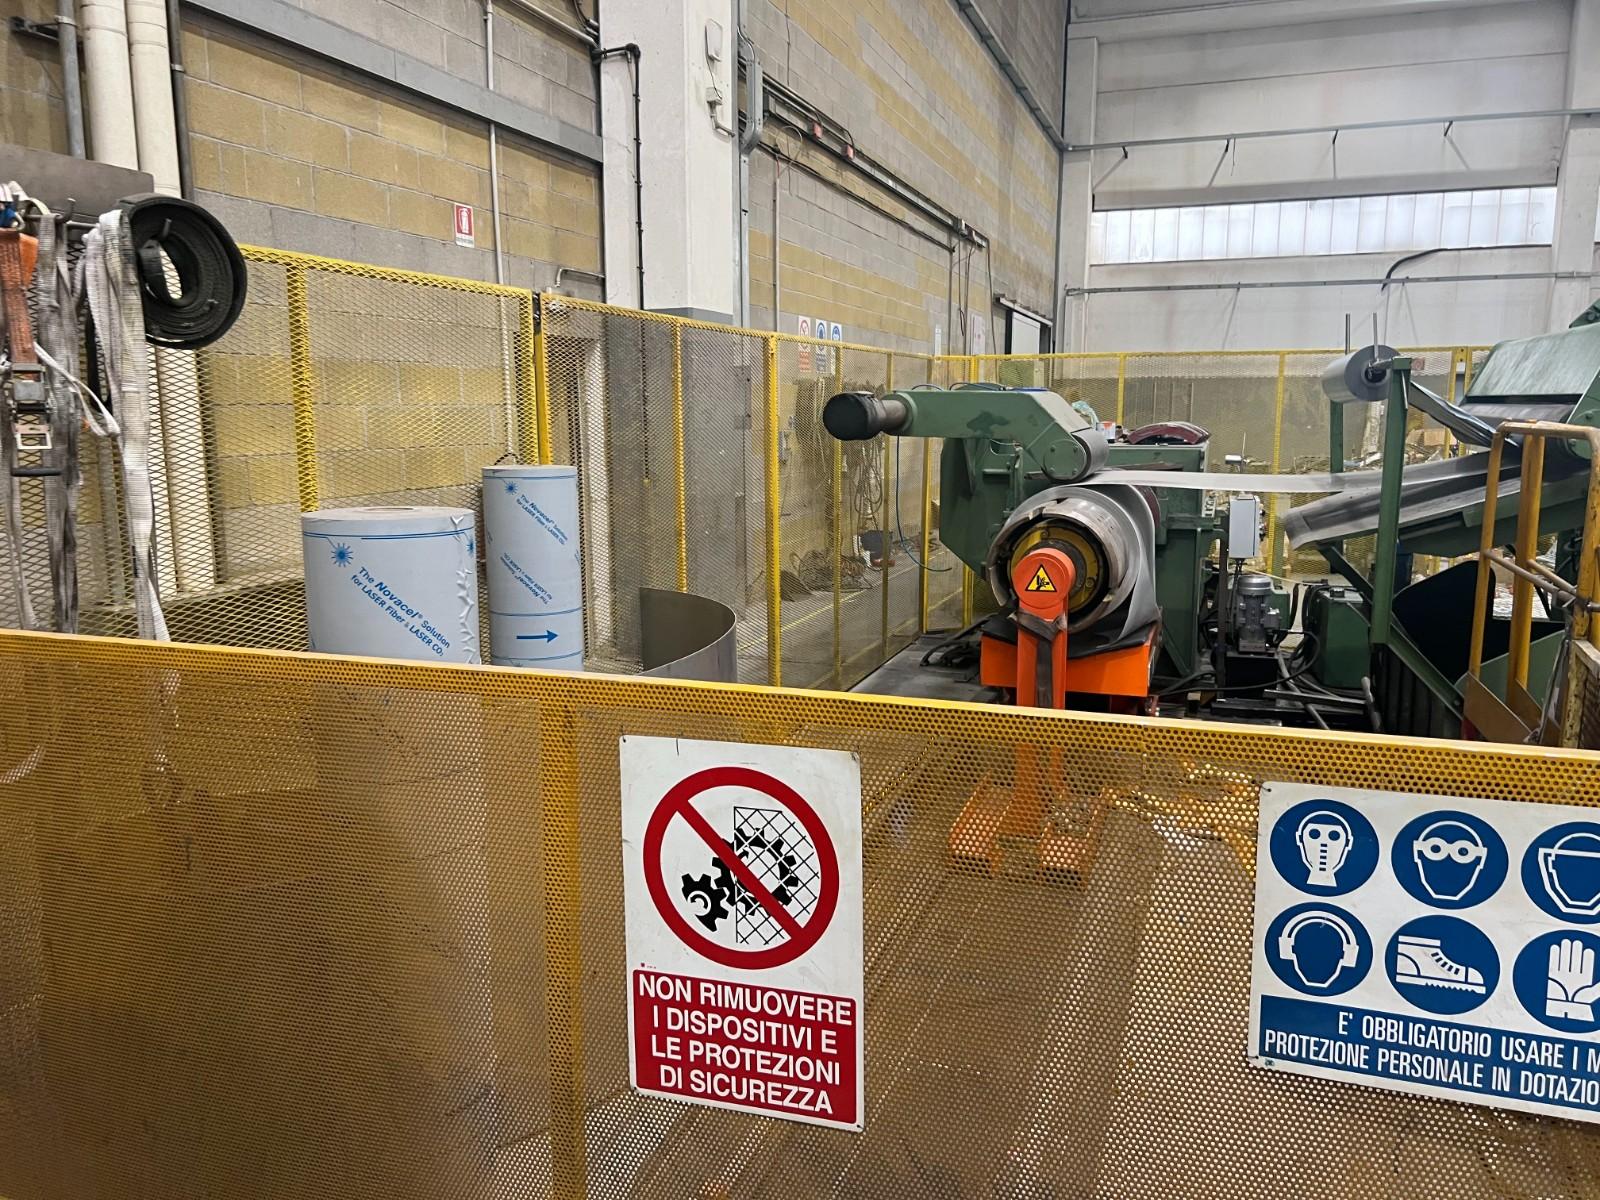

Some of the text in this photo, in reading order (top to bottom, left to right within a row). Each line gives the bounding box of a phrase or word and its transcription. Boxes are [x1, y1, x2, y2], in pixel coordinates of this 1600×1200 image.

[351, 574, 363, 587] for
[361, 585, 386, 608] LASER
[385, 606, 405, 623] Fiber
[409, 625, 433, 646] LASER
[359, 566, 375, 584] The
[421, 620, 450, 649] Solution
[639, 973, 852, 1026] NON RIMUOVERE
[653, 1005, 838, 1055] I DISPOSITIVI E
[1338, 1011, 1353, 1035] E'
[1362, 1015, 1492, 1058] OBBLIGATORIO
[1501, 1036, 1565, 1069] USARE
[1572, 1046, 1579, 1071] I
[651, 1034, 840, 1086] LE PROTEZIONI
[1264, 1029, 1599, 1106] PROTEZIONE PERSONALE IN DOTAZIO
[660, 1065, 833, 1114] DI SICUREZZA
